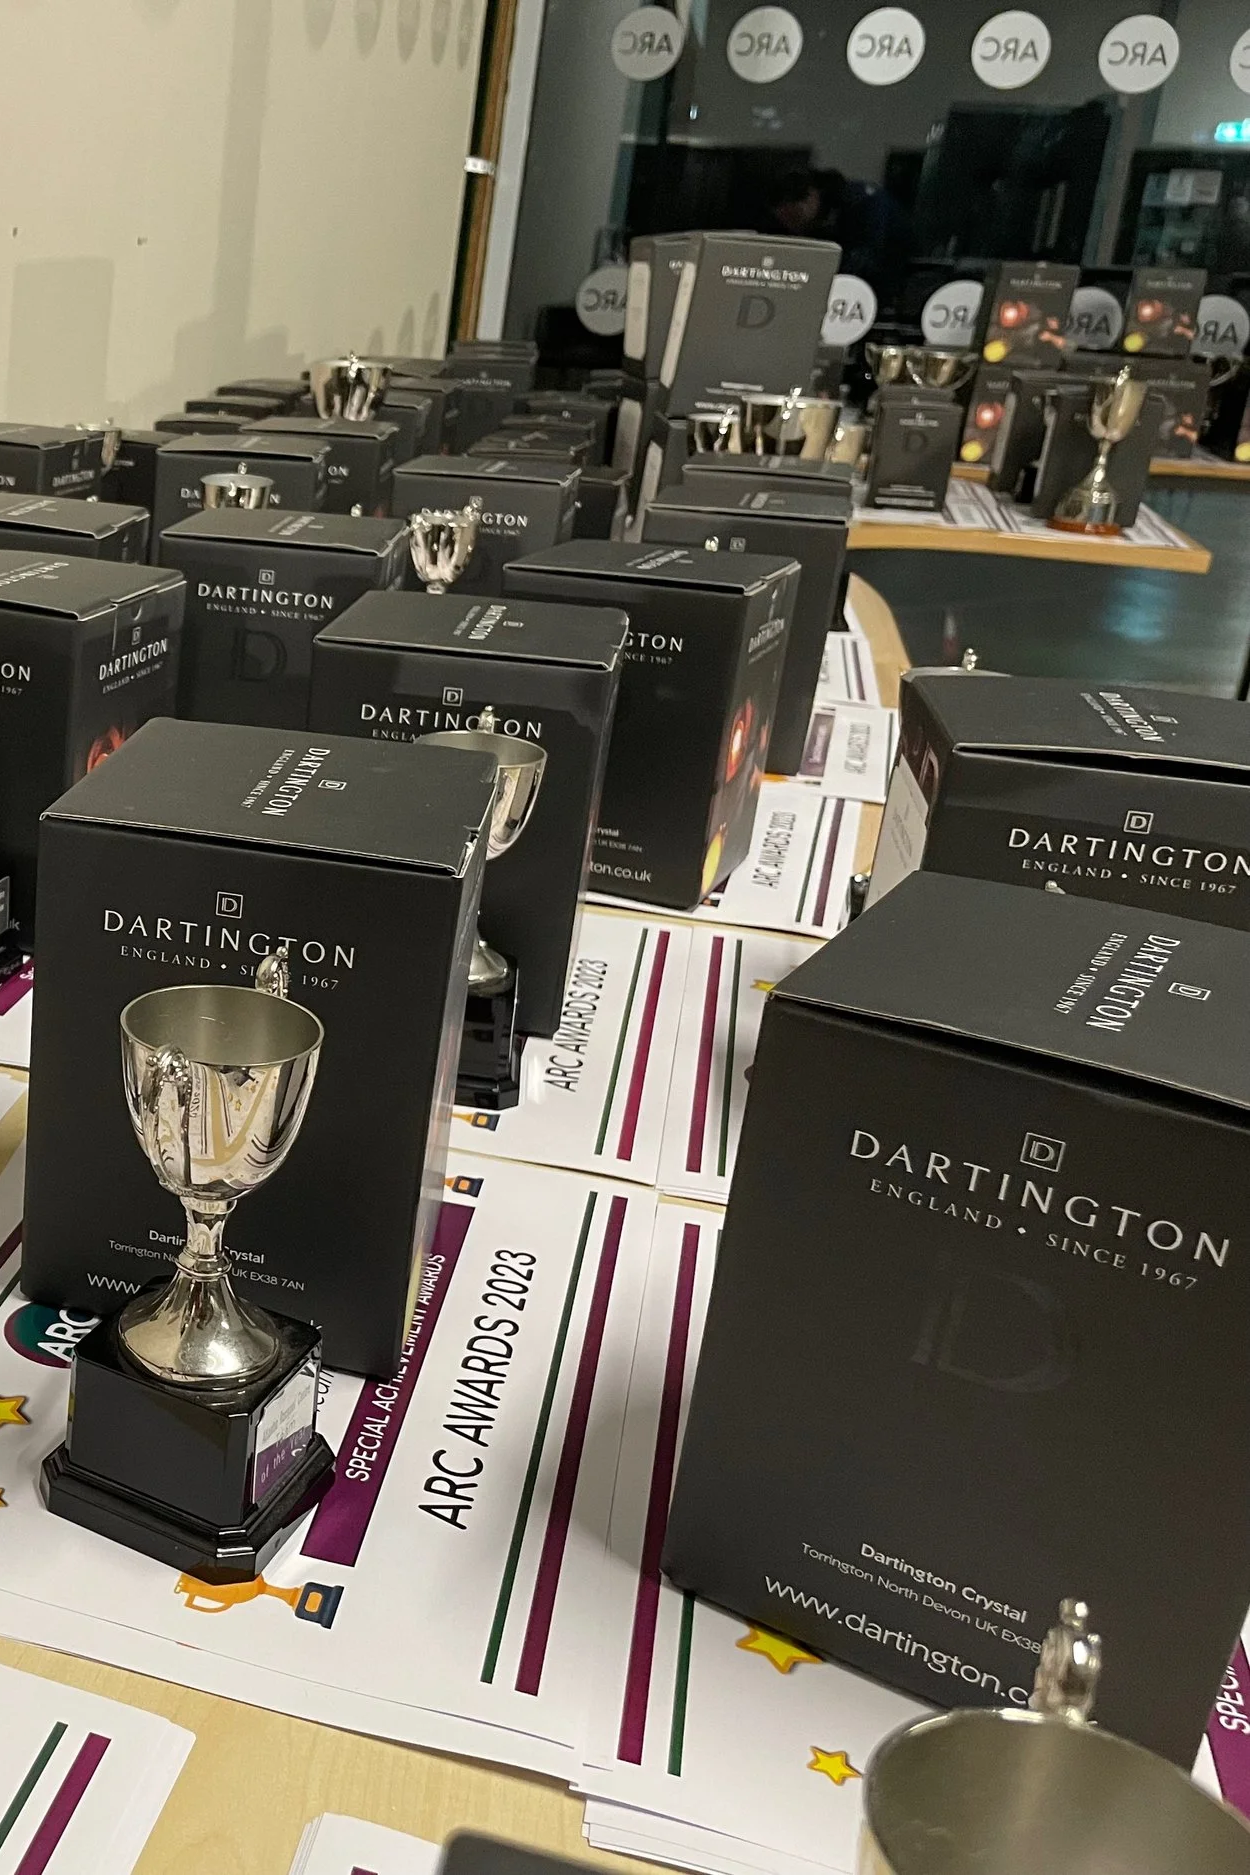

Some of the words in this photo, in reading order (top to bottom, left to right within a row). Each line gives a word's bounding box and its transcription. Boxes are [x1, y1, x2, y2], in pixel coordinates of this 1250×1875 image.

[197, 583, 334, 610] DARTINGTON
[206, 603, 257, 615] ENGLAND
[99, 638, 168, 681] DARTINGTON
[262, 748, 330, 816] DARTINGTON
[1022, 858, 1112, 880] ENGLAND
[1140, 873, 1191, 889] SINCE
[1200, 881, 1237, 895] 1967
[121, 946, 210, 969] ENGLAND
[302, 974, 339, 990] 1967
[572, 958, 608, 989] 2023
[1090, 933, 1128, 966] ENGLAND
[1066, 973, 1096, 996] SINCE
[1086, 934, 1181, 1032] DARTINGTON
[554, 990, 600, 1055] AWARDS
[543, 1055, 583, 1092] ARC
[850, 1130, 1230, 1268] DARTINGTON
[228, 1248, 265, 1265] rystal
[870, 1178, 1003, 1230] ENGLAND
[1046, 1232, 1127, 1269] SINCE
[1140, 1261, 1199, 1291] 1967
[108, 1239, 161, 1260] Torrington
[232, 1267, 248, 1278] UK
[250, 1271, 278, 1285] EX38
[281, 1278, 305, 1291] 7AN
[481, 1250, 537, 1311] 2023
[37, 1309, 100, 1362] ARC
[443, 1315, 519, 1447] AWARDS
[345, 1415, 390, 1482] SPECIAL
[418, 1449, 484, 1530] ARC
[802, 1542, 874, 1582] Torrington
[877, 1575, 919, 1602] North
[923, 1595, 970, 1624] Devon
[975, 1617, 998, 1636] UK
[1001, 1629, 1041, 1654] EX38
[861, 1543, 956, 1593] Dartington
[961, 1586, 1027, 1623] Crystal
[765, 1575, 1029, 1705] www.dartington.c
